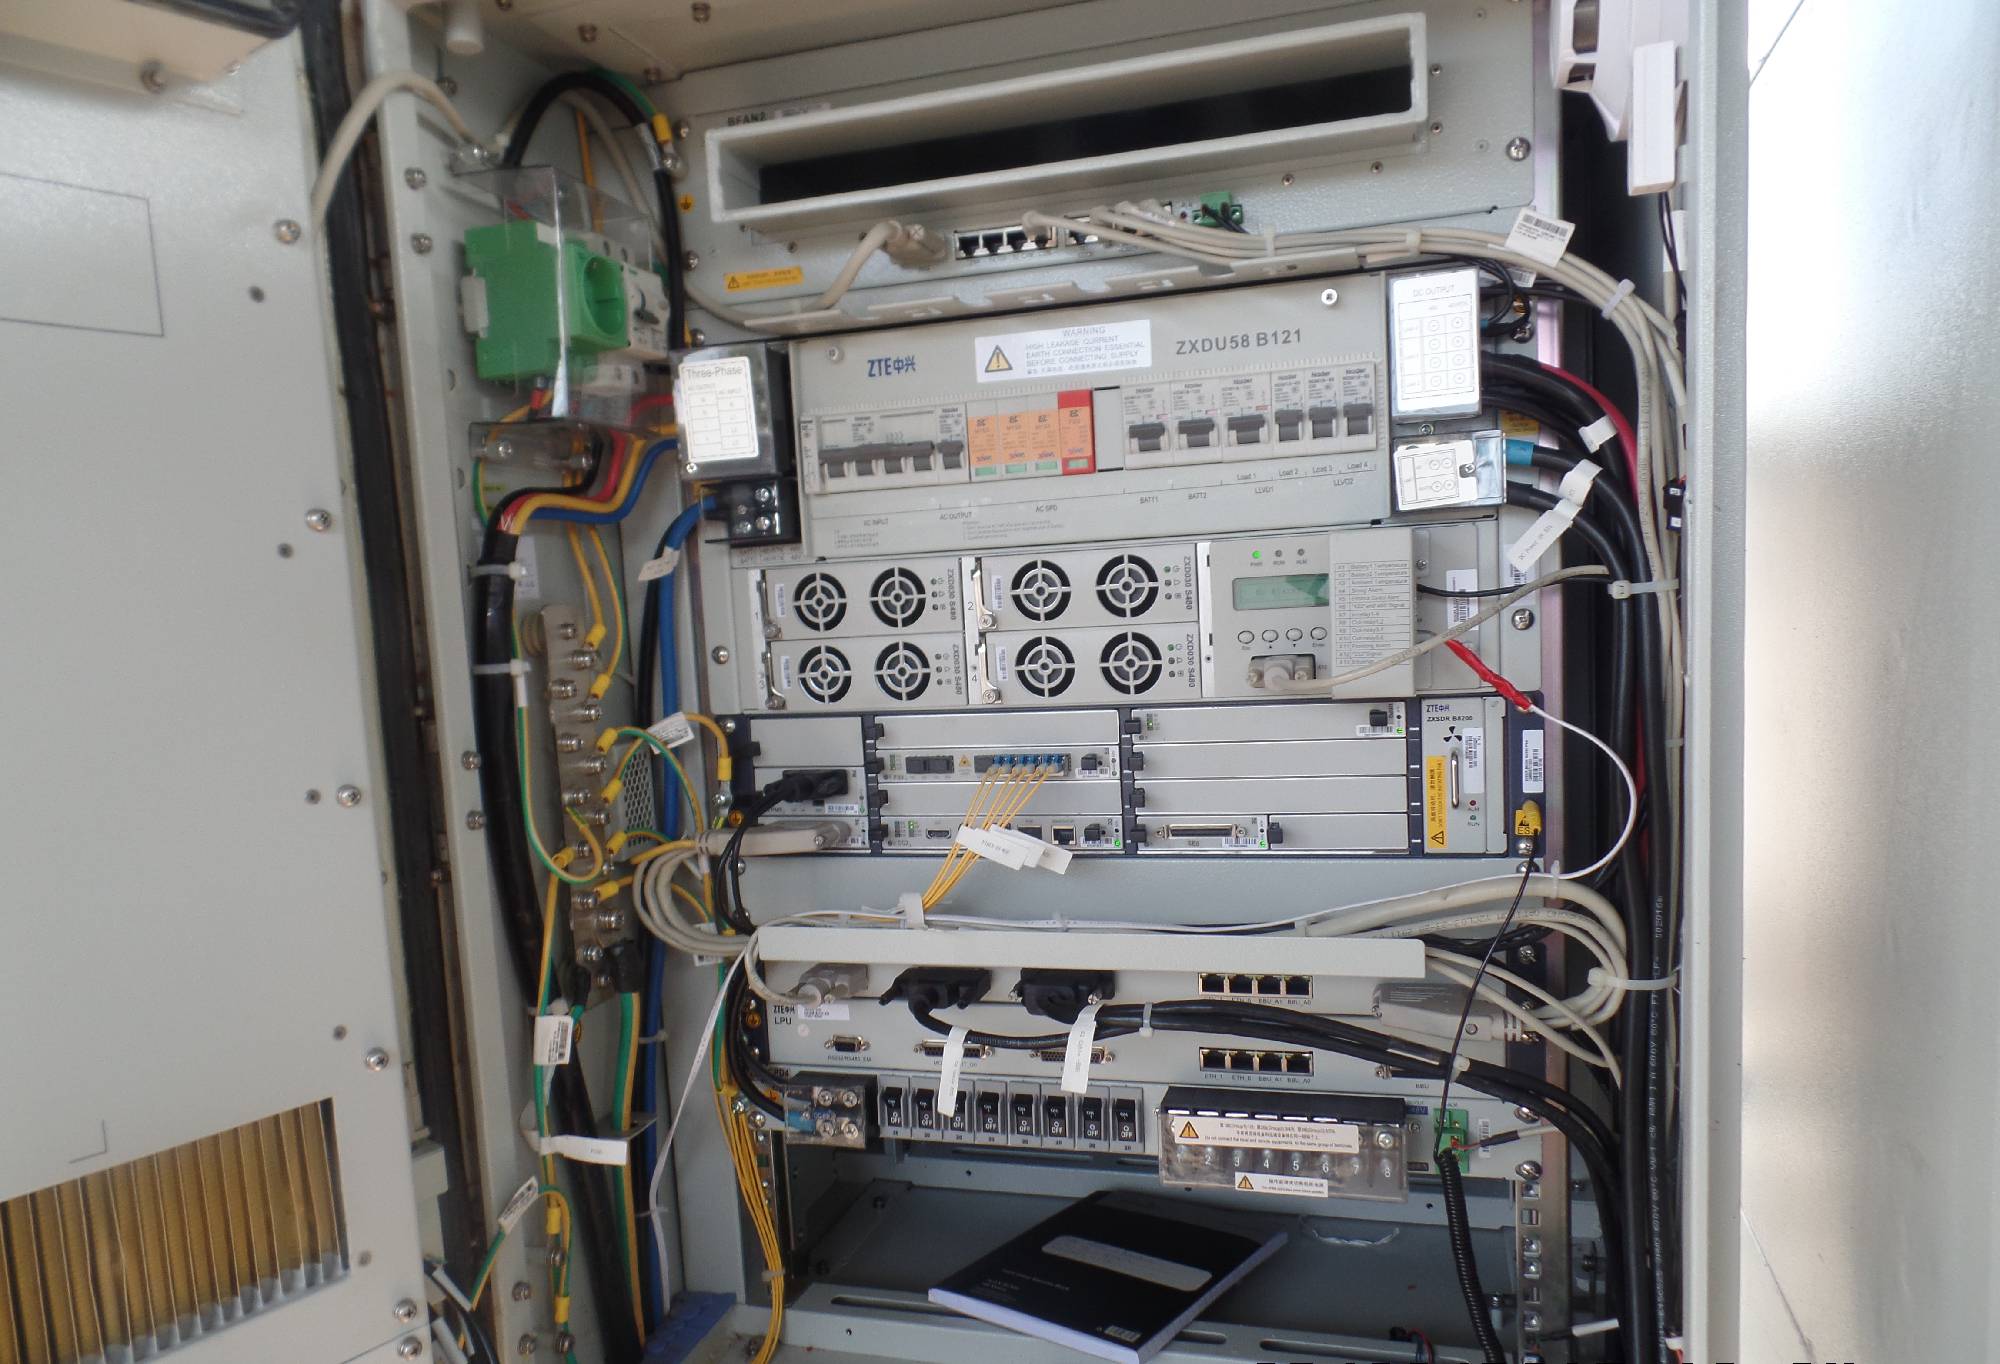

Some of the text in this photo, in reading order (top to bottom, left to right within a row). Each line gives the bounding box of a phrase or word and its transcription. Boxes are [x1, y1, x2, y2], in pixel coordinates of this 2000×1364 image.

[1062, 327, 1106, 337] WARNING
[1176, 327, 1302, 355] ZXDU58 B121
[686, 366, 742, 378] Three-Phase
[968, 602, 974, 611] 2
[972, 674, 977, 682] 4
[774, 1016, 792, 1025] LPU
[1204, 1154, 1212, 1166] 2
[1234, 1156, 1240, 1167] 3
[1264, 1158, 1270, 1168] 4
[1293, 1160, 1300, 1171] 5
[1322, 1163, 1328, 1173] 6
[1353, 1164, 1360, 1174] 7
[1384, 1168, 1391, 1178] 8
